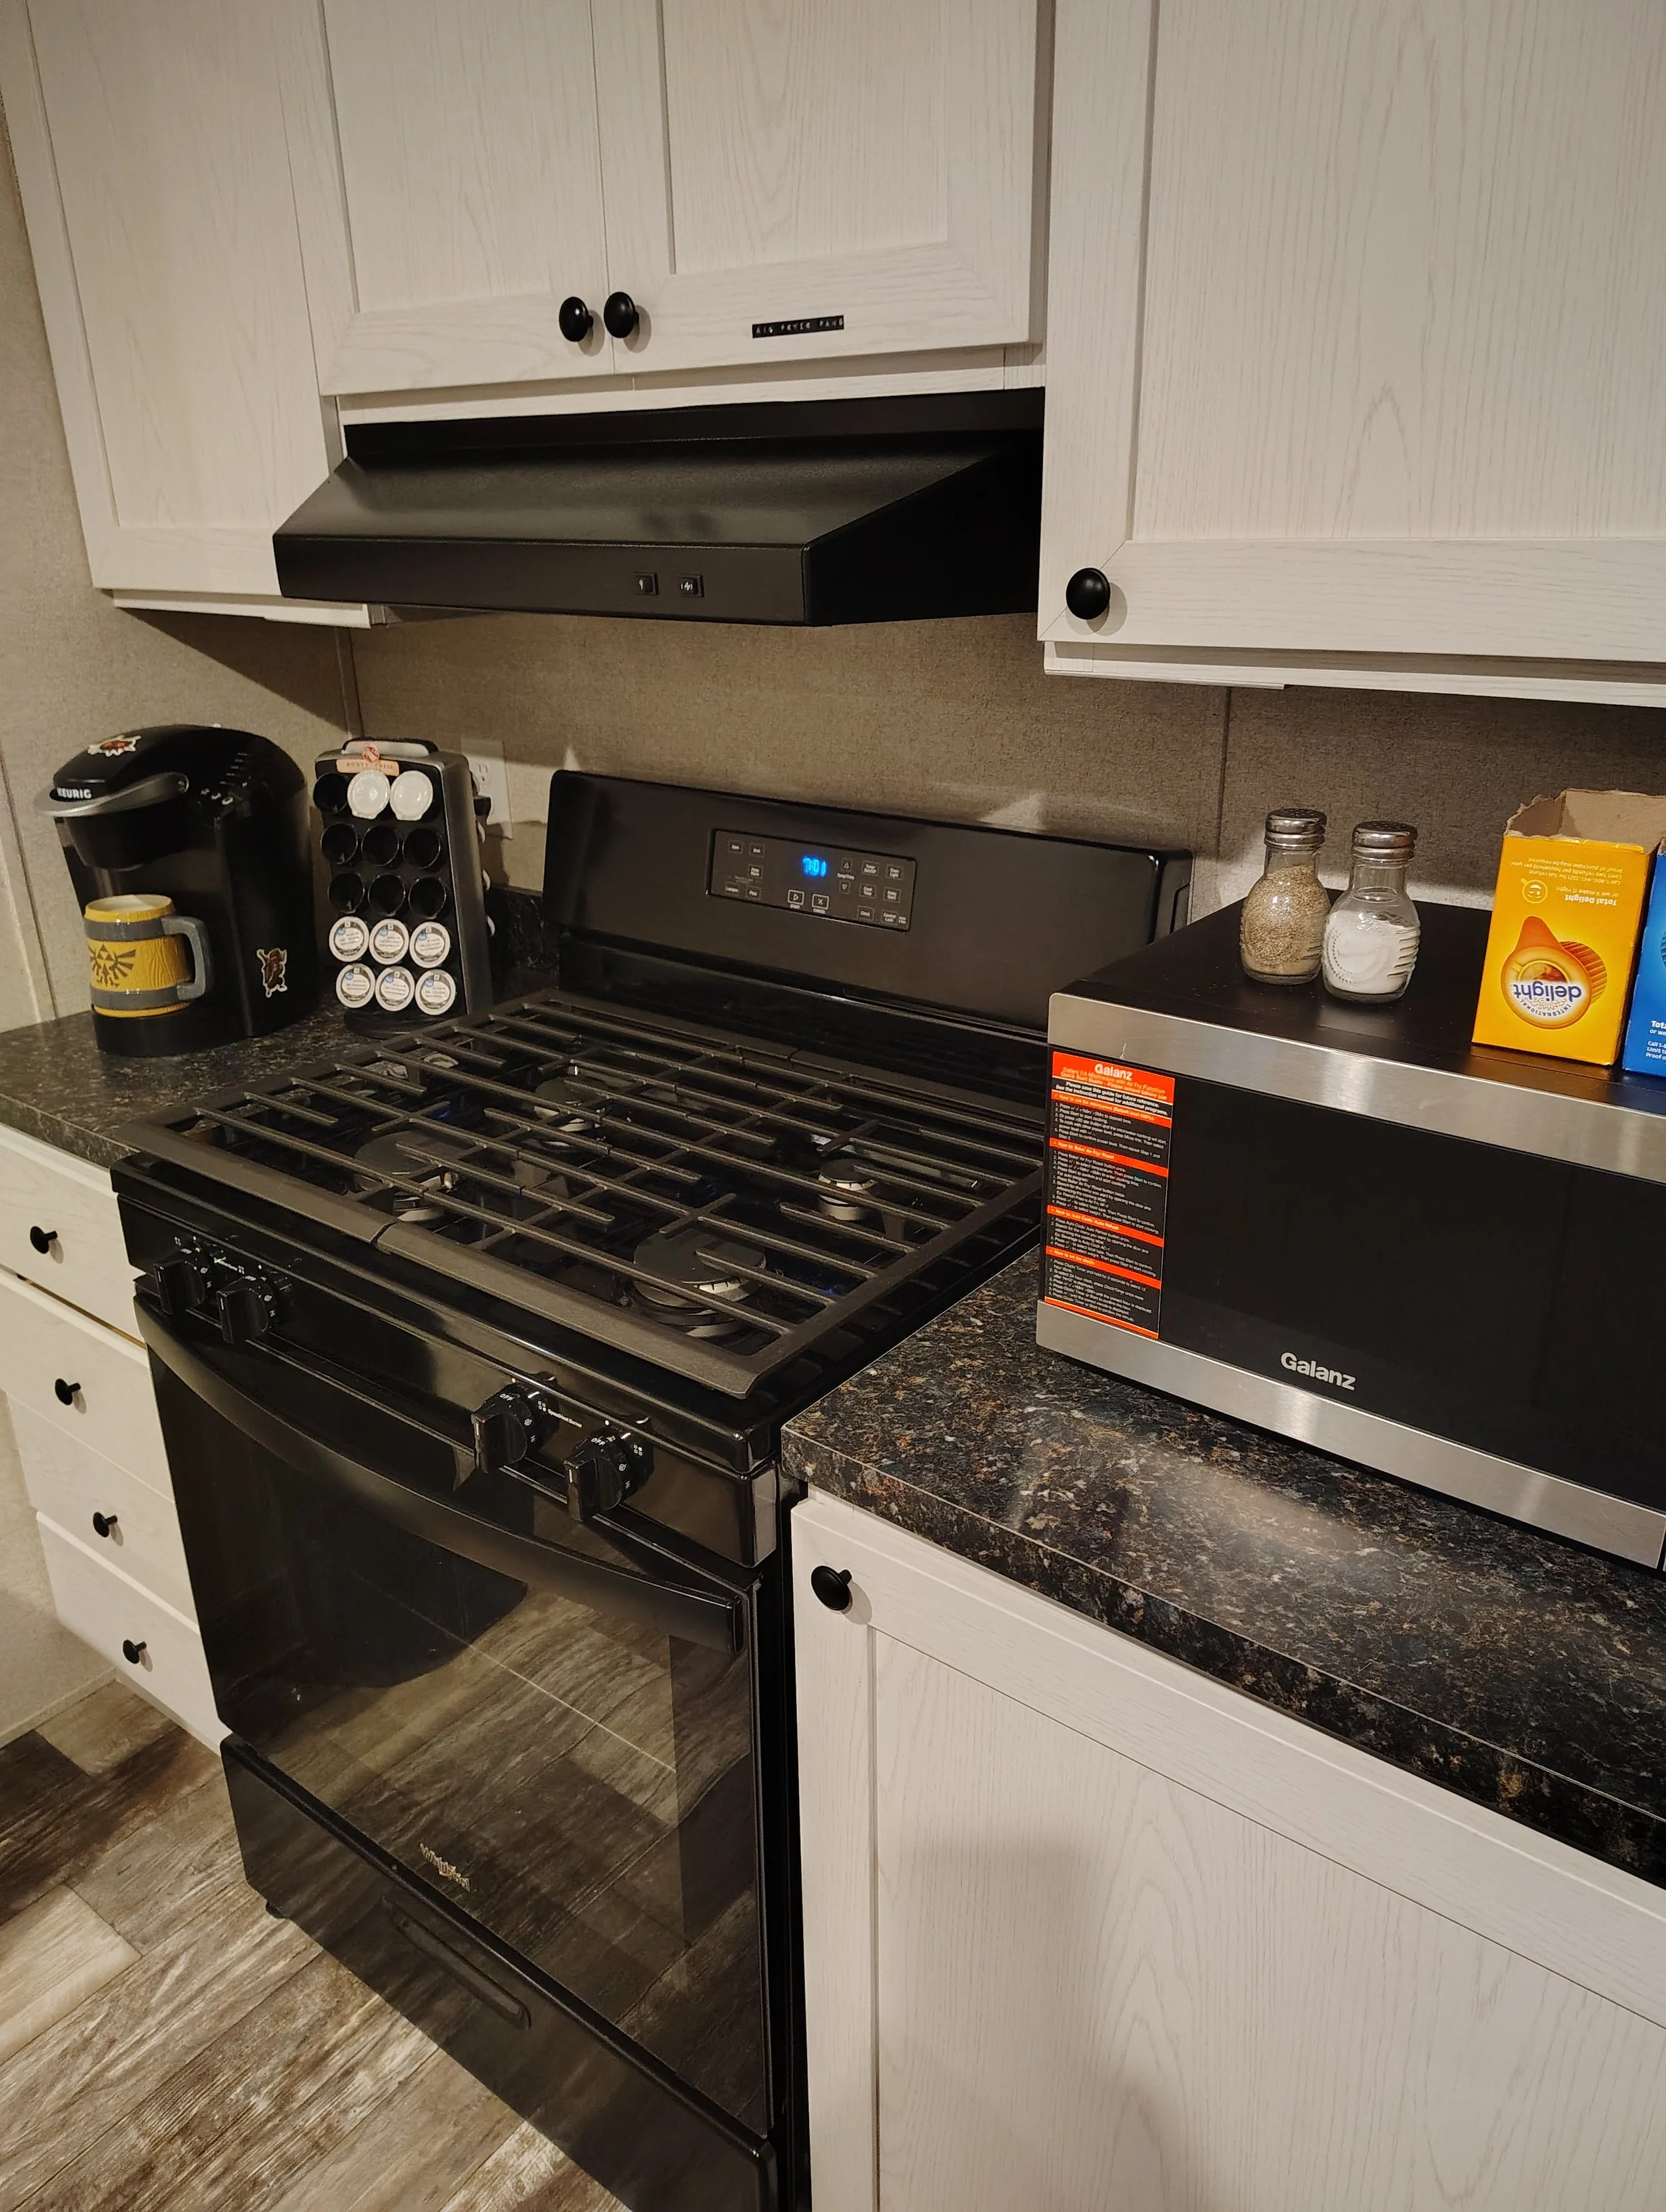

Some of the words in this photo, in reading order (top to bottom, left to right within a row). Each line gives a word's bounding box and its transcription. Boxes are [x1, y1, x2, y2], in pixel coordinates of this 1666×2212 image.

[57, 787, 92, 799] KEURIG
[1564, 893, 1595, 903] Delight
[1595, 897, 1617, 906] Total
[1513, 981, 1582, 1002] delight
[1520, 999, 1571, 1017] INTERNATIONAL
[1094, 1062, 1133, 1081] Galanz
[1280, 1352, 1356, 1391] Galanz
[591, 1437, 606, 1446] OFF
